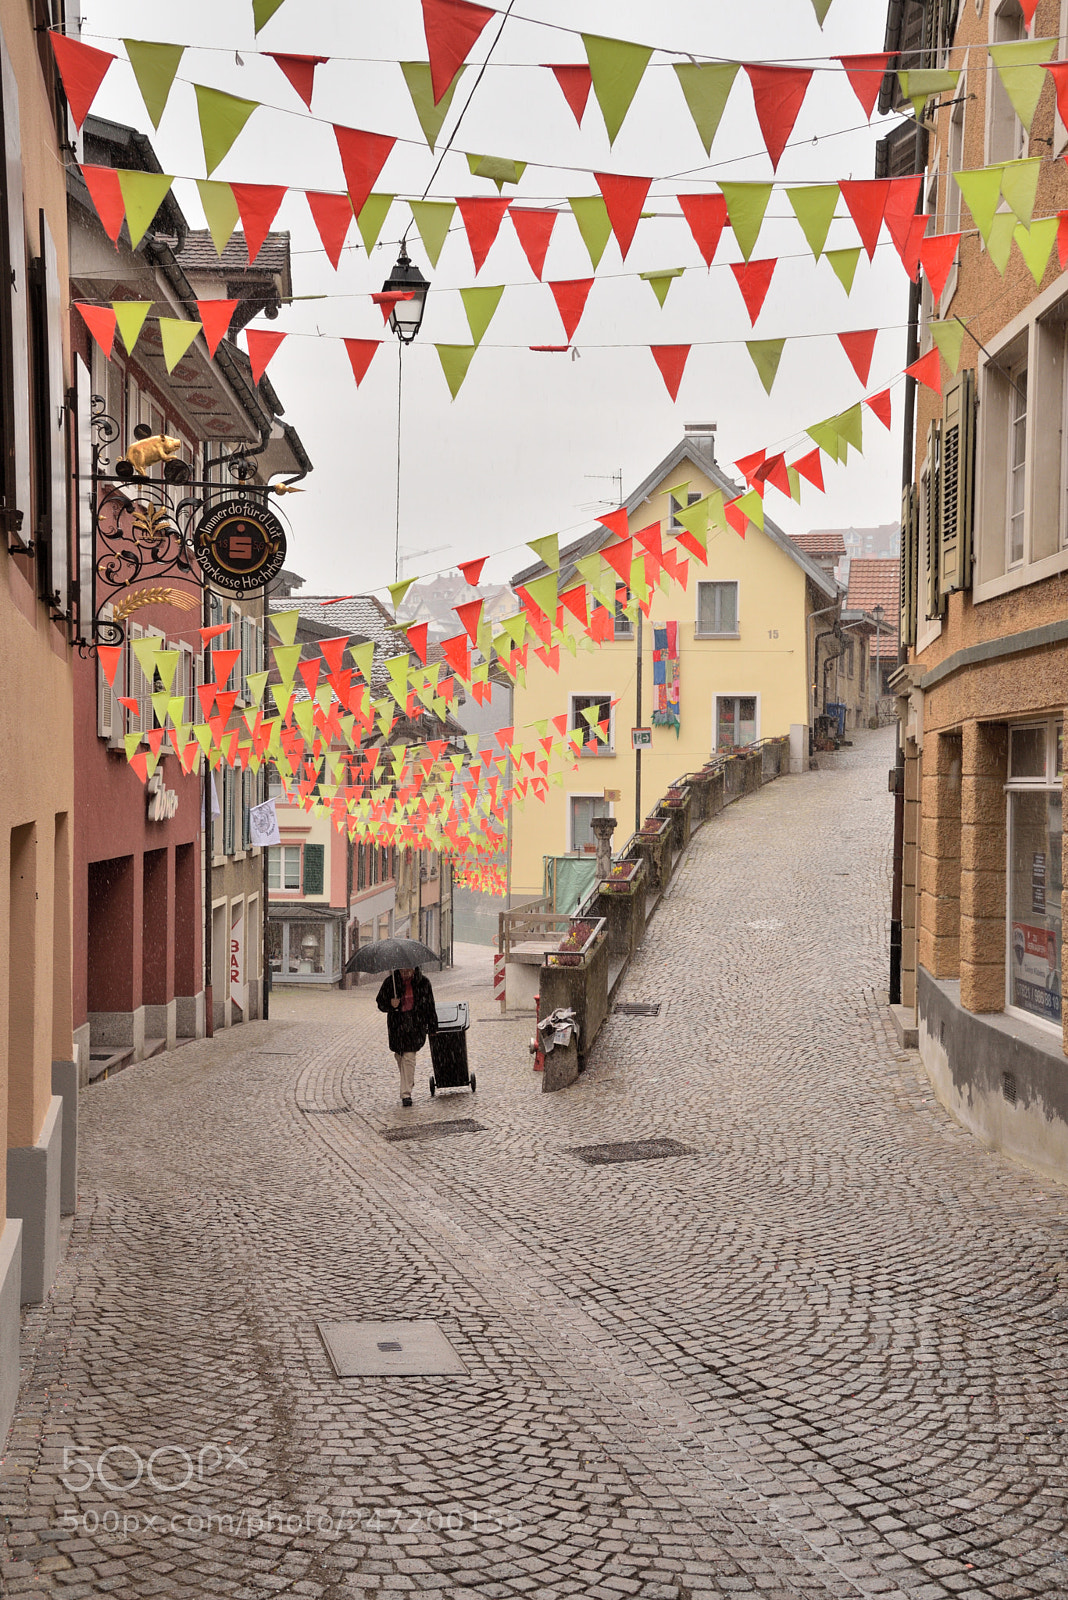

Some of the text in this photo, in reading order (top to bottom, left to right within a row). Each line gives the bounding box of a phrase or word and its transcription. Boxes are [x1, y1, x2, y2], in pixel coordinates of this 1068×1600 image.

[200, 509, 227, 534] Immer
[228, 502, 242, 515] do
[243, 502, 260, 517] für
[197, 547, 285, 588] Sparkasse Hochrhein
[767, 629, 779, 639] 15
[231, 939, 240, 984] BAR
